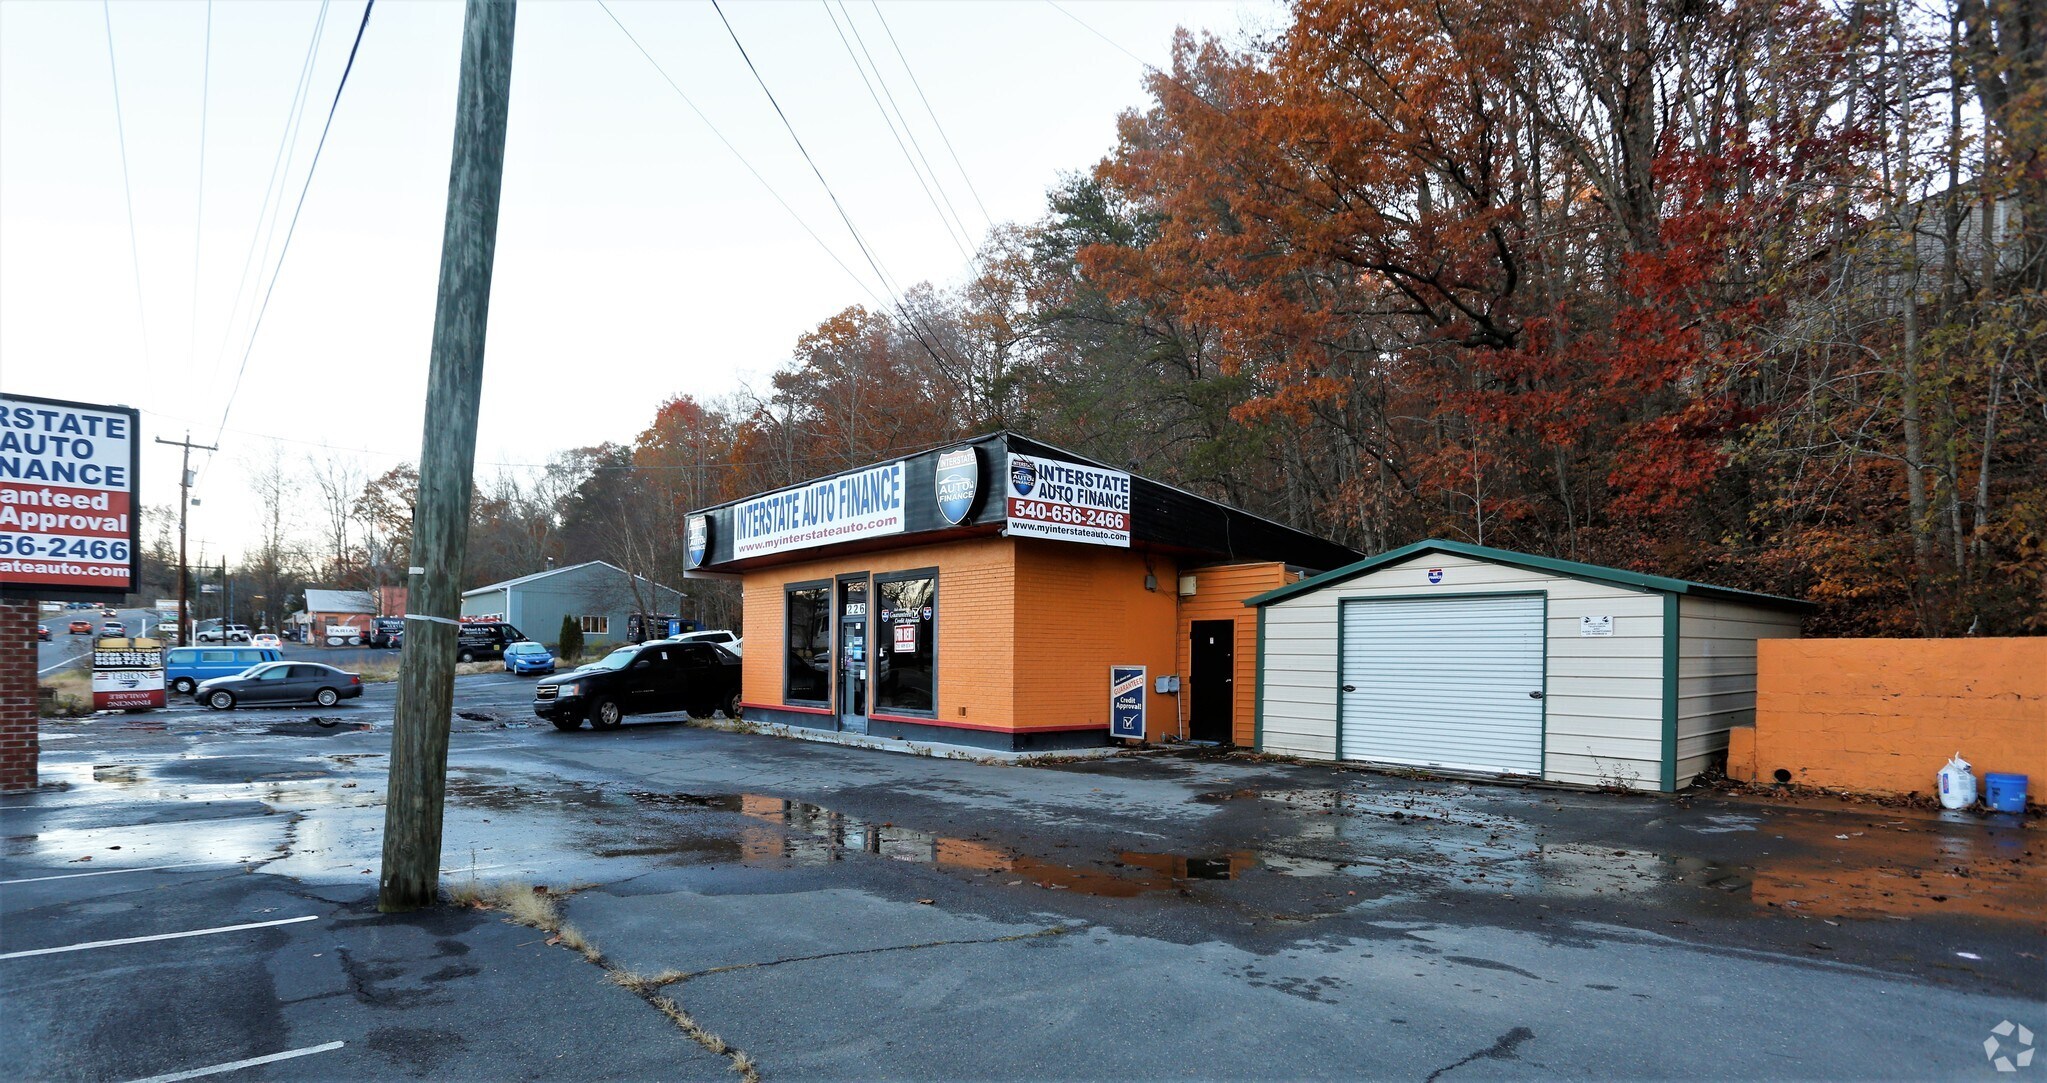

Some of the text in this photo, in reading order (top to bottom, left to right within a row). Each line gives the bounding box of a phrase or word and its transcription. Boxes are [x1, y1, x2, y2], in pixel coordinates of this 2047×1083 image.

[0, 431, 94, 460] AUTO
[0, 456, 125, 487] NANCE
[941, 453, 975, 467] INTERSTATE
[1038, 463, 1129, 494] INTERSTATE
[0, 488, 109, 511] anteed
[736, 465, 900, 541] INTERSTATE AUTO FINANCE
[940, 490, 974, 503] FINANCE
[1038, 482, 1128, 511] AUTO FINANCE
[0, 505, 127, 532] Approval
[1014, 500, 1124, 529] 540-656-2466
[738, 516, 897, 553] www.myinterstateauto.com
[1012, 521, 1127, 541] www.myinterstateauto.com
[0, 534, 128, 561] 56-2466
[0, 560, 130, 577] ateauto.com
[847, 604, 865, 614] 226
[112, 672, 149, 680] NOBEL
[1113, 677, 1143, 695] GUARANTEED
[1116, 702, 1142, 710] Approval!
[1120, 696, 1136, 704] Credit
